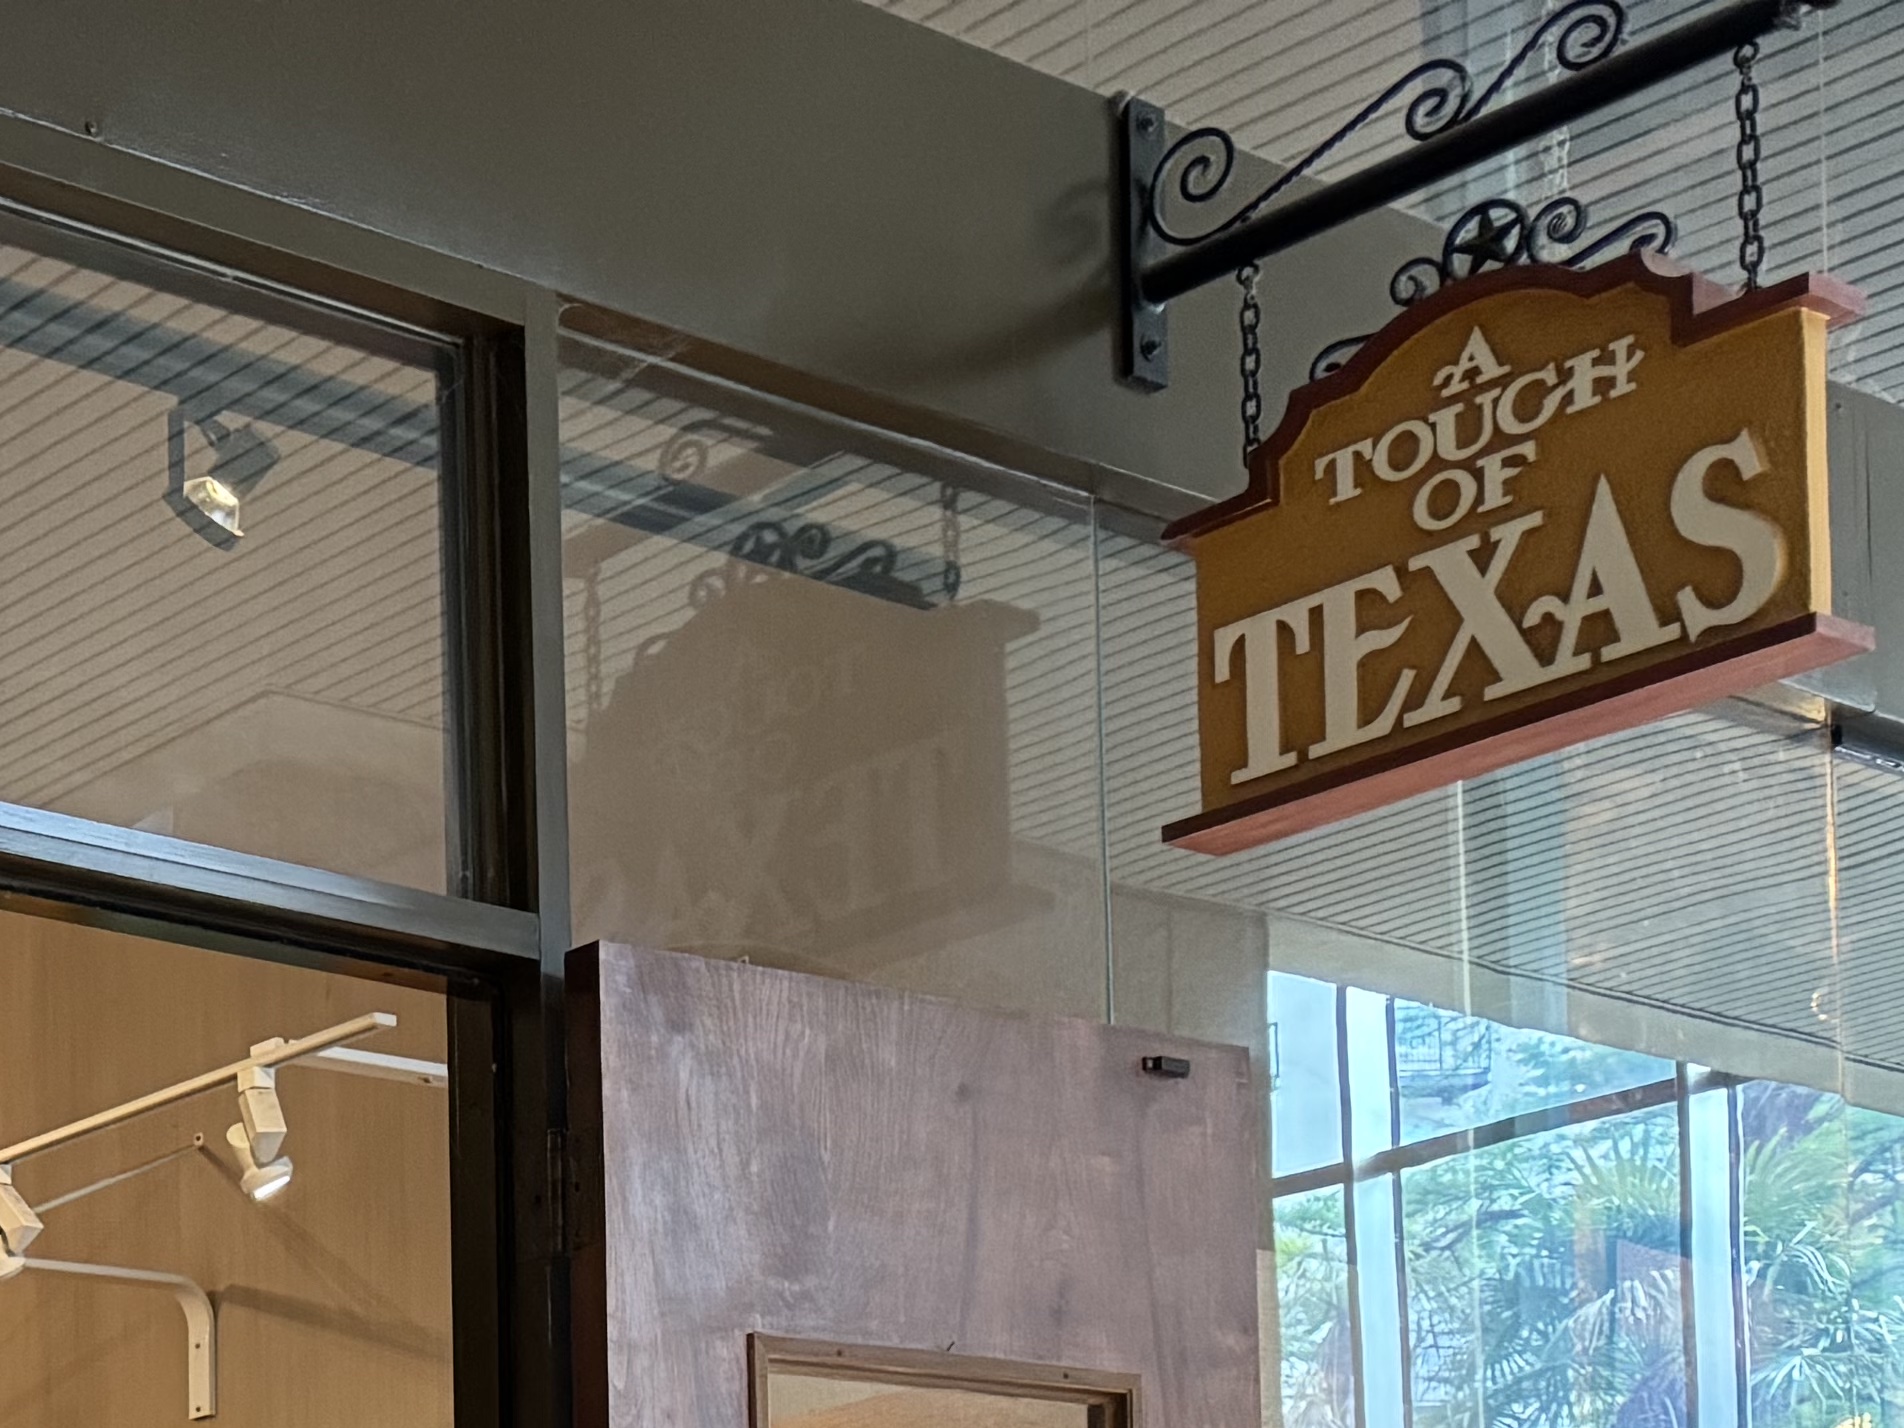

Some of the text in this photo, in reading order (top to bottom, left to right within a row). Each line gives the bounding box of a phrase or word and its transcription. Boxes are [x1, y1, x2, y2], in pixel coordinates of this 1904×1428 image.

[1313, 334, 1645, 505] TOUCH
[1433, 324, 1511, 399] A
[1412, 441, 1537, 532] OF
[1213, 428, 1790, 785] TEXAS
